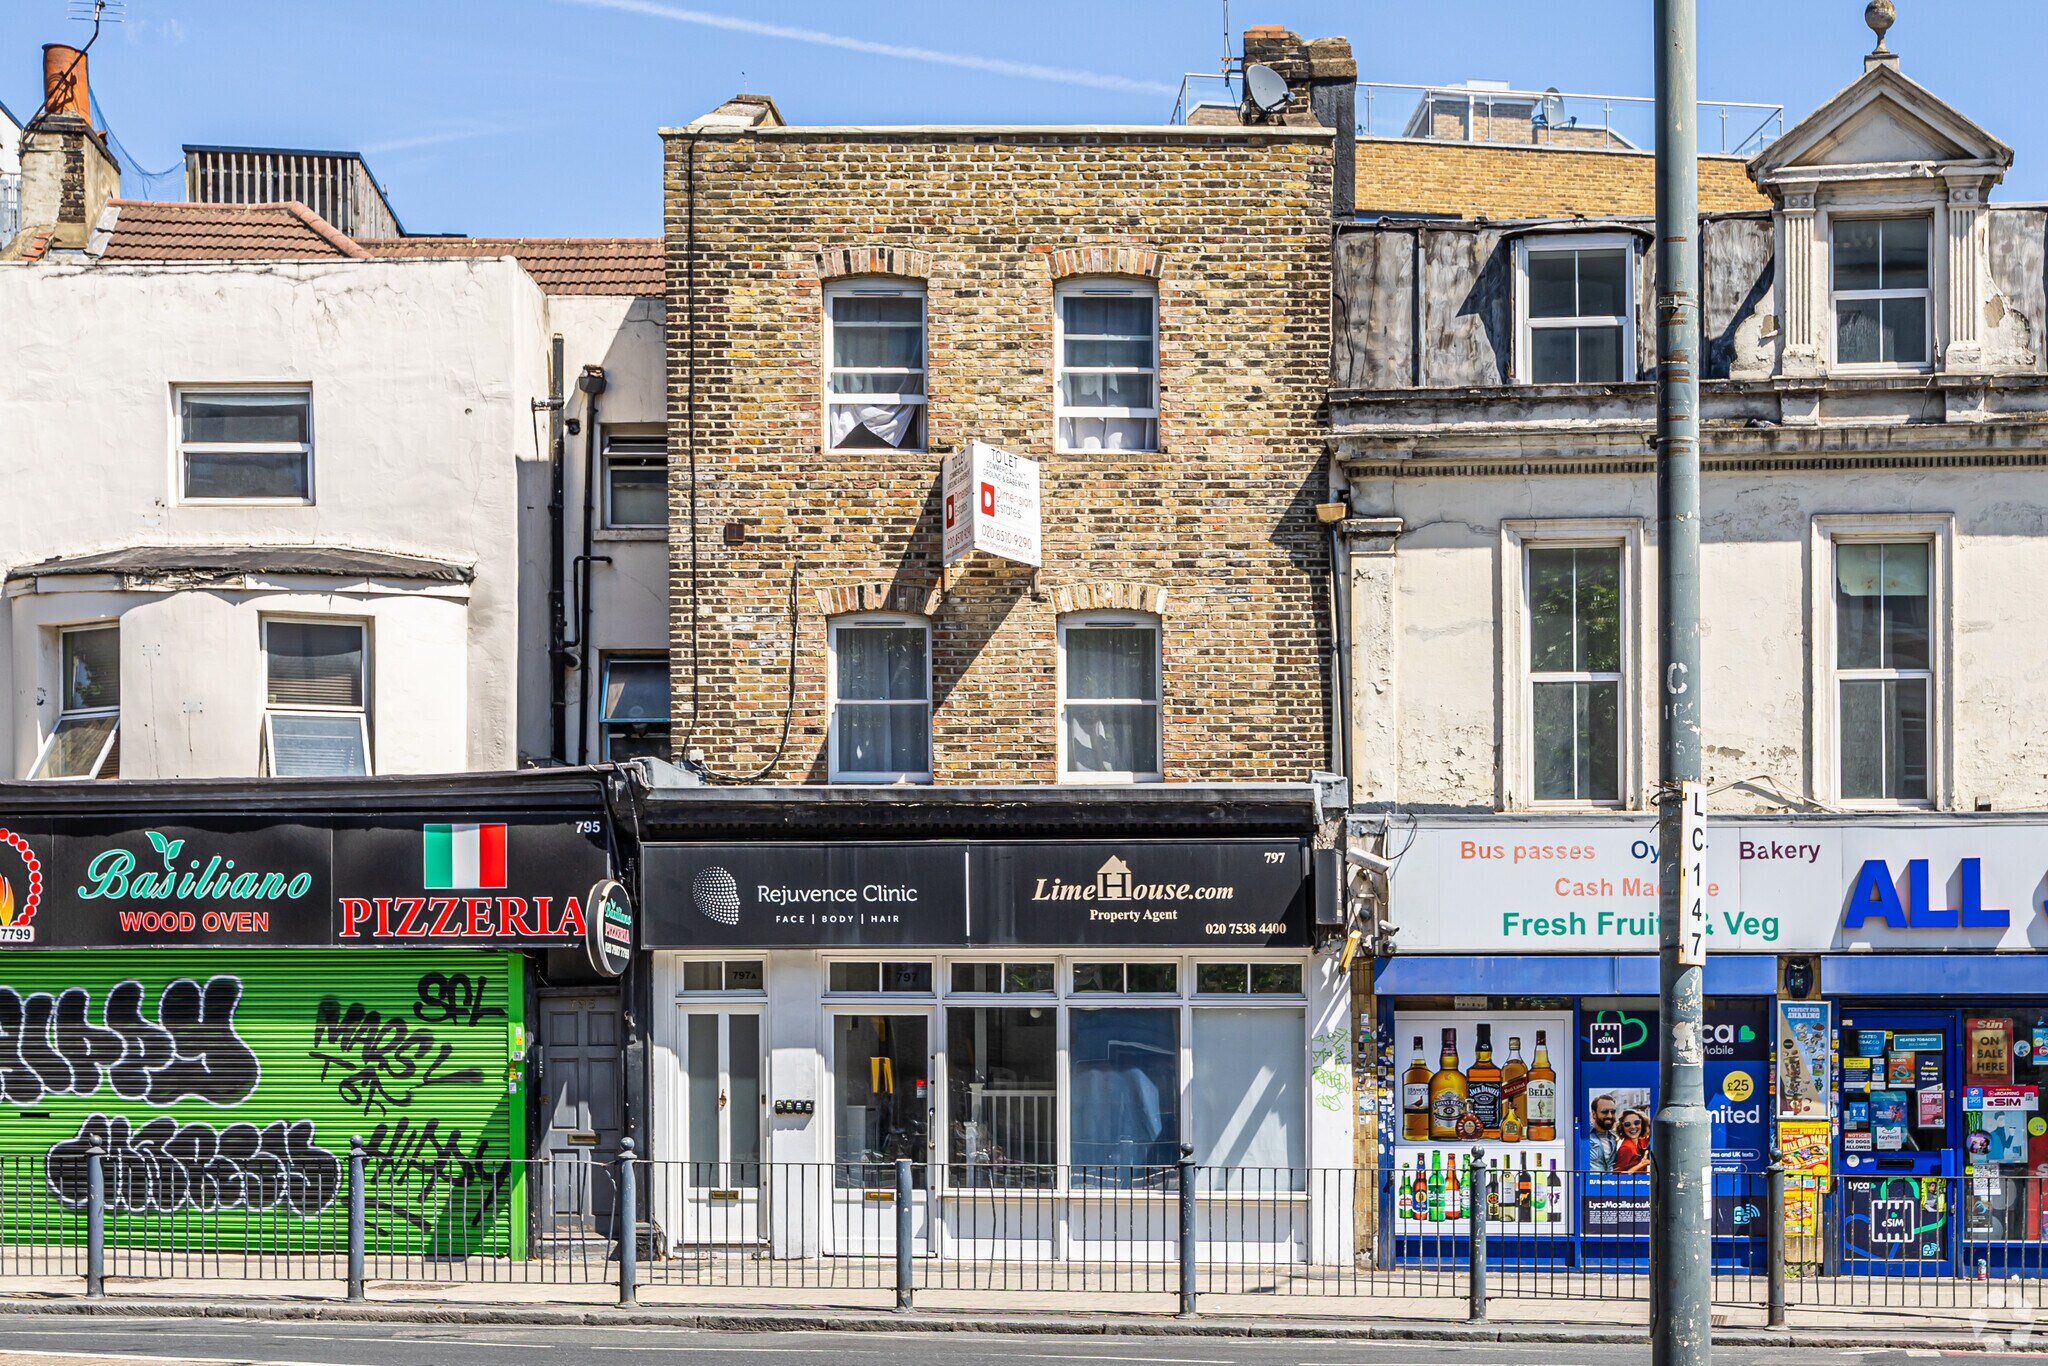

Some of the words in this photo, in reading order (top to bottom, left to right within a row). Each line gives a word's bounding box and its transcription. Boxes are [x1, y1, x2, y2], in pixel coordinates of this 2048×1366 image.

[991, 448, 1002, 464] TO
[1003, 453, 1018, 470] LET
[996, 486, 1034, 509] Dimension
[996, 500, 1022, 519] Estates
[982, 524, 995, 539] 020
[996, 529, 1012, 544] 8510
[1014, 534, 1032, 550] 9290
[1667, 662, 1688, 695] C
[575, 820, 601, 833] 795
[1264, 852, 1286, 864] 797
[1460, 841, 1509, 860] Bus
[1513, 845, 1596, 864] passes
[1739, 841, 1821, 863] Bakery
[77, 848, 313, 900] Basiliano
[1554, 877, 1614, 897] Cash
[1843, 857, 2010, 928] ALL
[757, 885, 858, 905] Rejuvence
[863, 884, 918, 903] Clinic
[119, 911, 196, 933] WOOD
[202, 911, 270, 933] OVEN
[339, 896, 587, 938] PIZZERIA
[776, 915, 806, 924] FACE
[821, 915, 854, 924] BODY
[871, 915, 900, 924] HAIR
[1090, 909, 1141, 923] Property
[1143, 909, 1178, 922] Agent
[1205, 923, 1227, 935] 020
[1229, 923, 1257, 935] 7538
[1258, 923, 1287, 935] 4400
[1503, 912, 1586, 936] Fresh
[1723, 912, 1779, 942] Veg
[0, 929, 32, 941] 7799
[896, 972, 918, 983] 797
[1977, 1020, 2003, 1029] Sun
[1597, 1036, 1615, 1044] eSIM
[1702, 1023, 1735, 1044] ca
[1980, 1036, 2000, 1046] ON
[1977, 1049, 2003, 1058] SALE
[1977, 1062, 2005, 1072] HERE
[1528, 1087, 1554, 1097] BELL'S
[1727, 1079, 1749, 1092] £25
[1848, 1181, 1870, 1191] Lyca
[1881, 1218, 1904, 1228] eSIM
